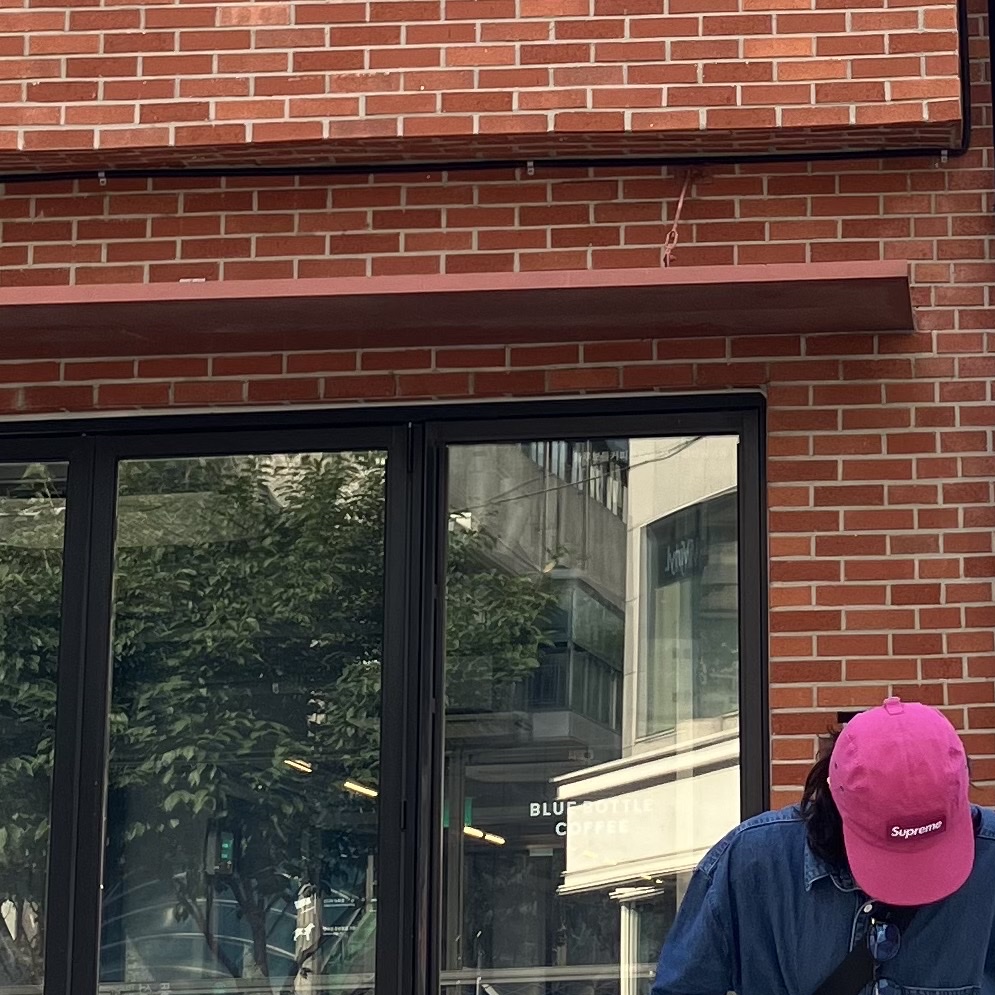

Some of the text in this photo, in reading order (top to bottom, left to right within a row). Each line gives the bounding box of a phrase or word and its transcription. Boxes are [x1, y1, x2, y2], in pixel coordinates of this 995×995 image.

[529, 799, 654, 817] BLUE BOTTLE
[555, 820, 629, 836] COFFEE
[891, 820, 943, 839] Supreme
